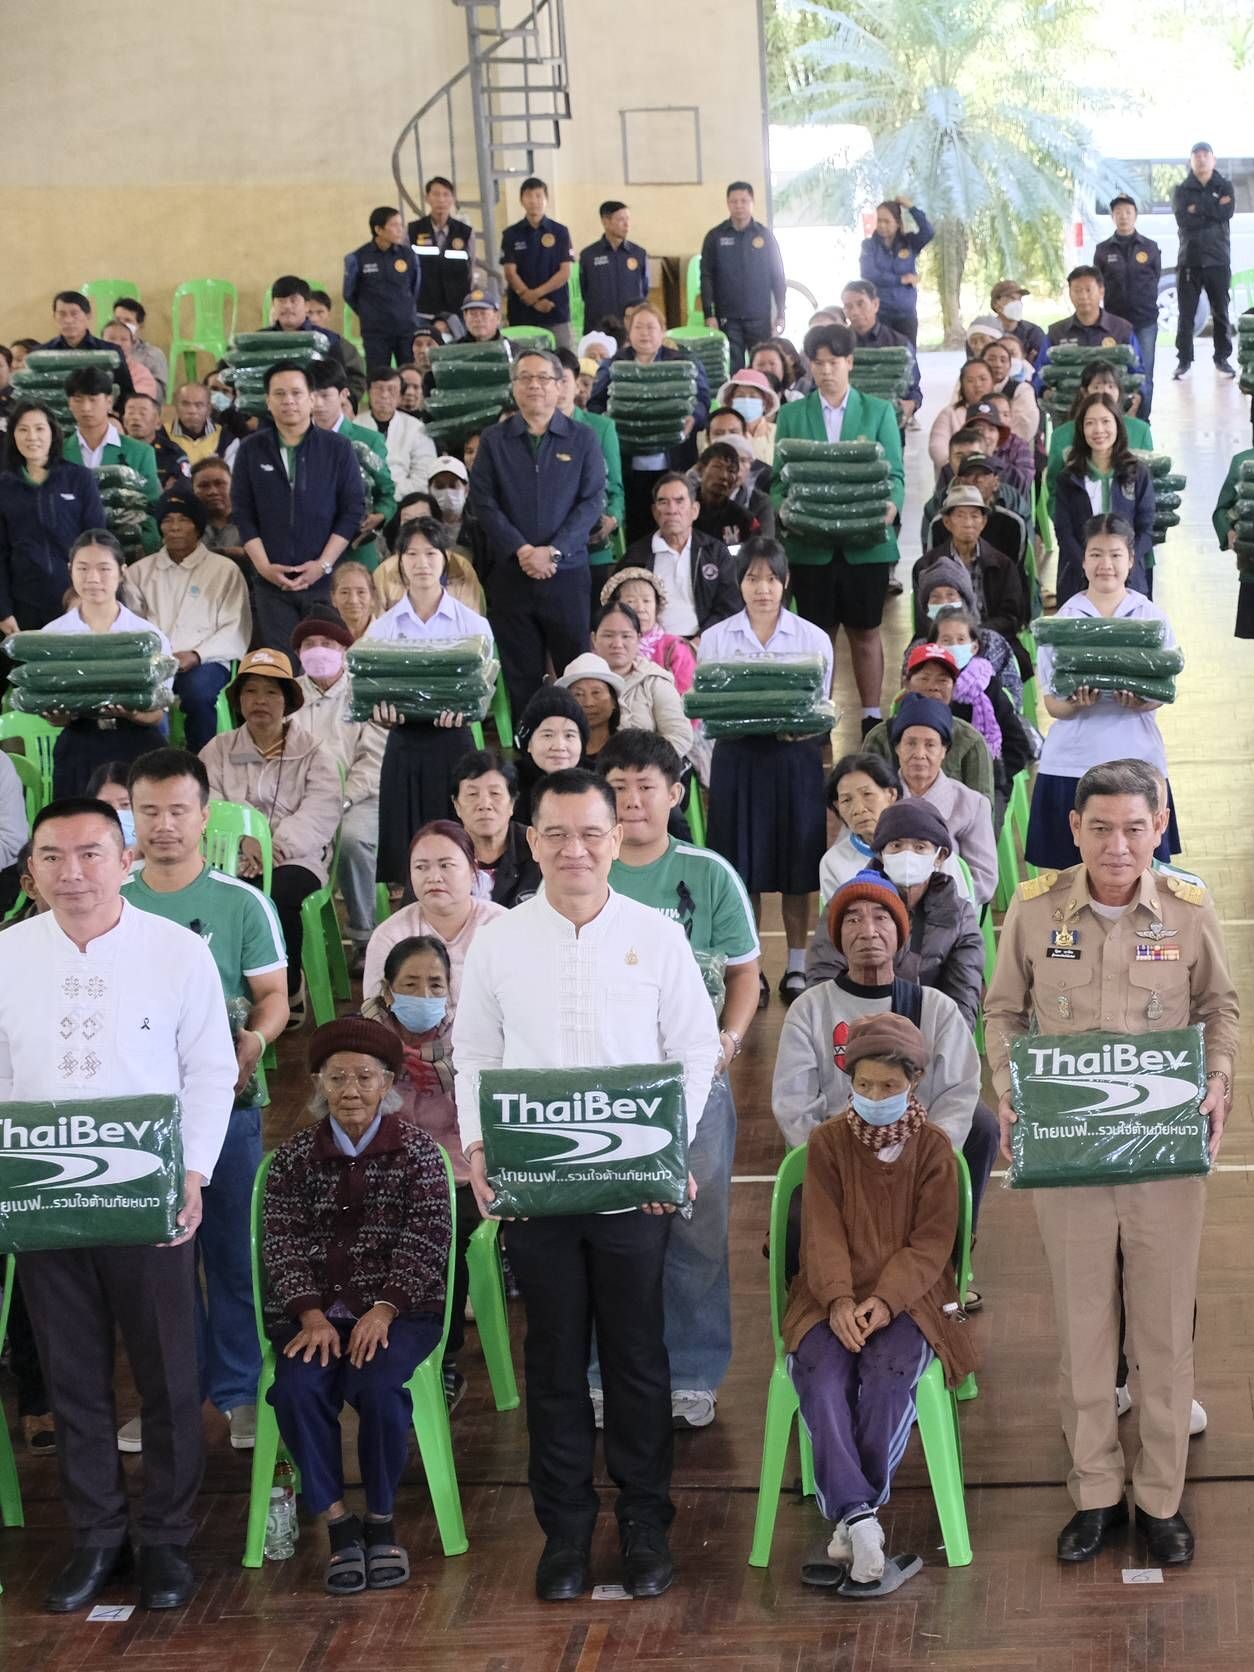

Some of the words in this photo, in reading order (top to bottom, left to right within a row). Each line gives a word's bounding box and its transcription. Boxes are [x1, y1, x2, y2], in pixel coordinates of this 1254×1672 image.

[1028, 1043, 1189, 1076] ThaiBev
[492, 1091, 662, 1123] ThaiBev
[0, 1115, 152, 1148] haiBev
